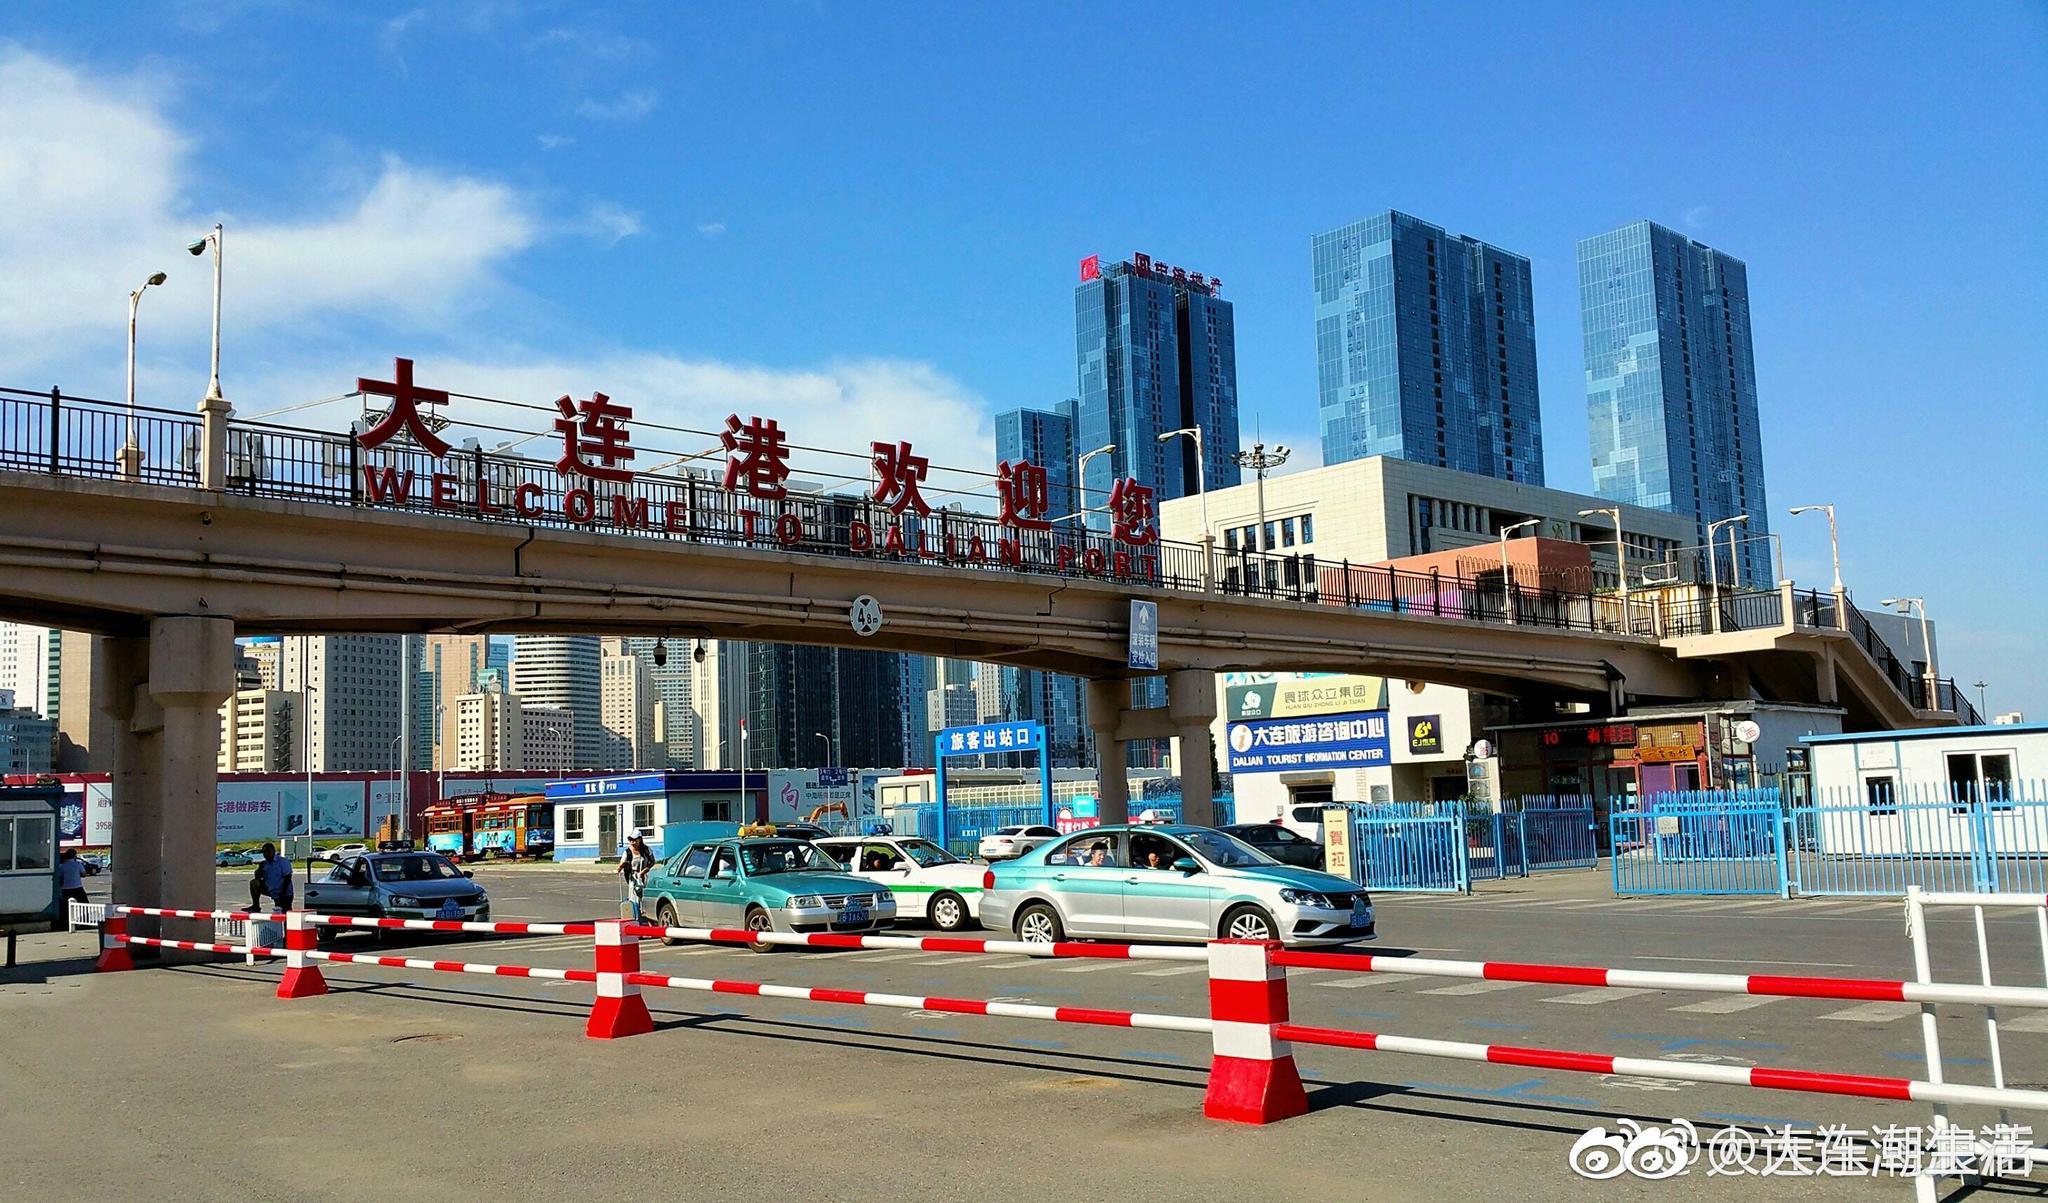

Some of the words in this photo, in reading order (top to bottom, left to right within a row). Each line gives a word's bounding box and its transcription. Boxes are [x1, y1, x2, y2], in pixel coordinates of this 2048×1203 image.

[357, 357, 1159, 547] 大连港欢迎您
[363, 464, 690, 535] WELCOME
[736, 508, 802, 546] TO
[849, 520, 1022, 567] DALIAN
[1058, 545, 1157, 581] PORT
[950, 727, 1030, 751] 旅客出站口
[1253, 717, 1386, 747] 大连旅游咨询中心
[1233, 755, 1264, 767] DALIAN
[1267, 753, 1303, 765] TOURIST
[1304, 750, 1347, 763] INFORMATION
[1348, 748, 1384, 761] CENTER
[961, 829, 978, 837] EXIT
